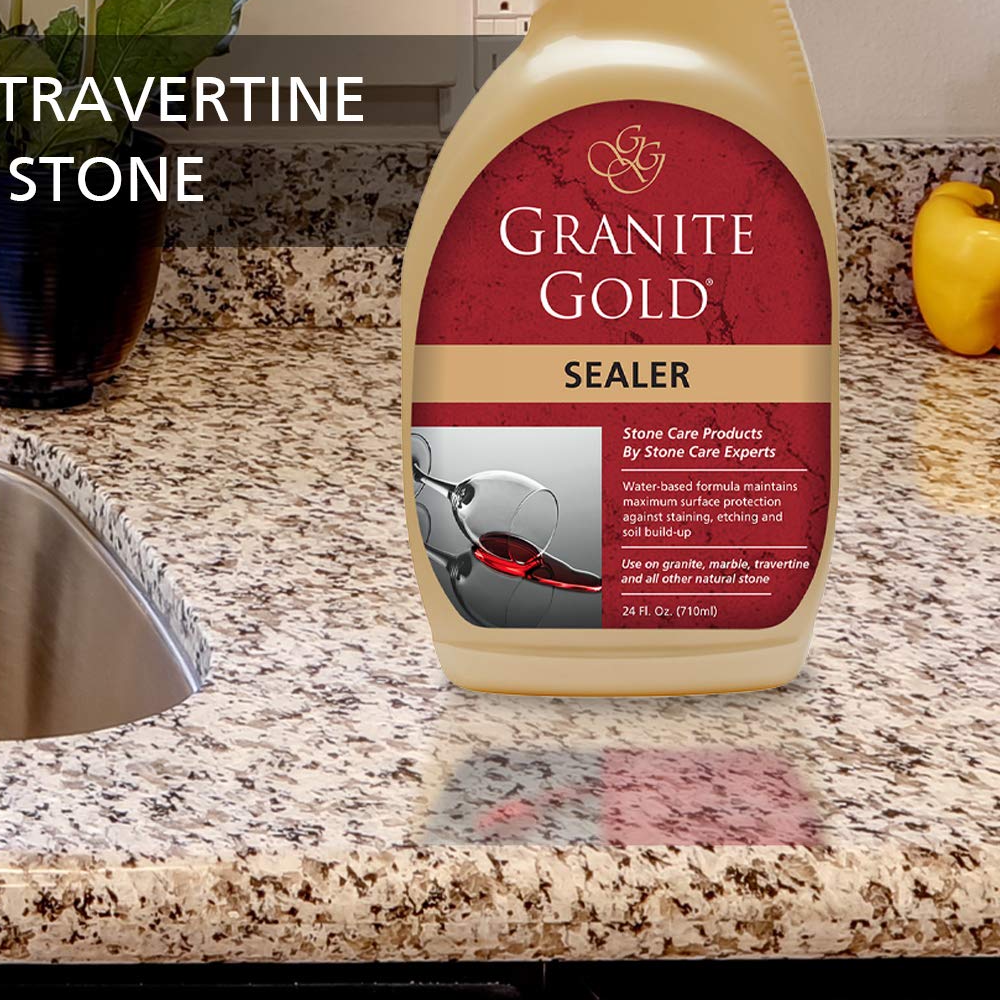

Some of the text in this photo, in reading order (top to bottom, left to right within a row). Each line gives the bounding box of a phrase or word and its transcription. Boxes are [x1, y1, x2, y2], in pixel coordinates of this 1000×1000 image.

[499, 206, 754, 256] GRANITE
[564, 361, 690, 389] SEALER
[622, 426, 763, 440] Stone Care Products
[622, 445, 777, 462] By Stone Care Experts
[622, 480, 798, 492] Water-based formula maintains
[623, 495, 782, 509] maximum surface protection
[622, 511, 783, 525] against staining, etching and
[622, 526, 692, 540] soil build-up
[621, 558, 810, 572] Use on granite, marble, travertine
[620, 572, 771, 584] and all other natural stone
[622, 605, 718, 618] 24 Fl. Oz. (710ml)
